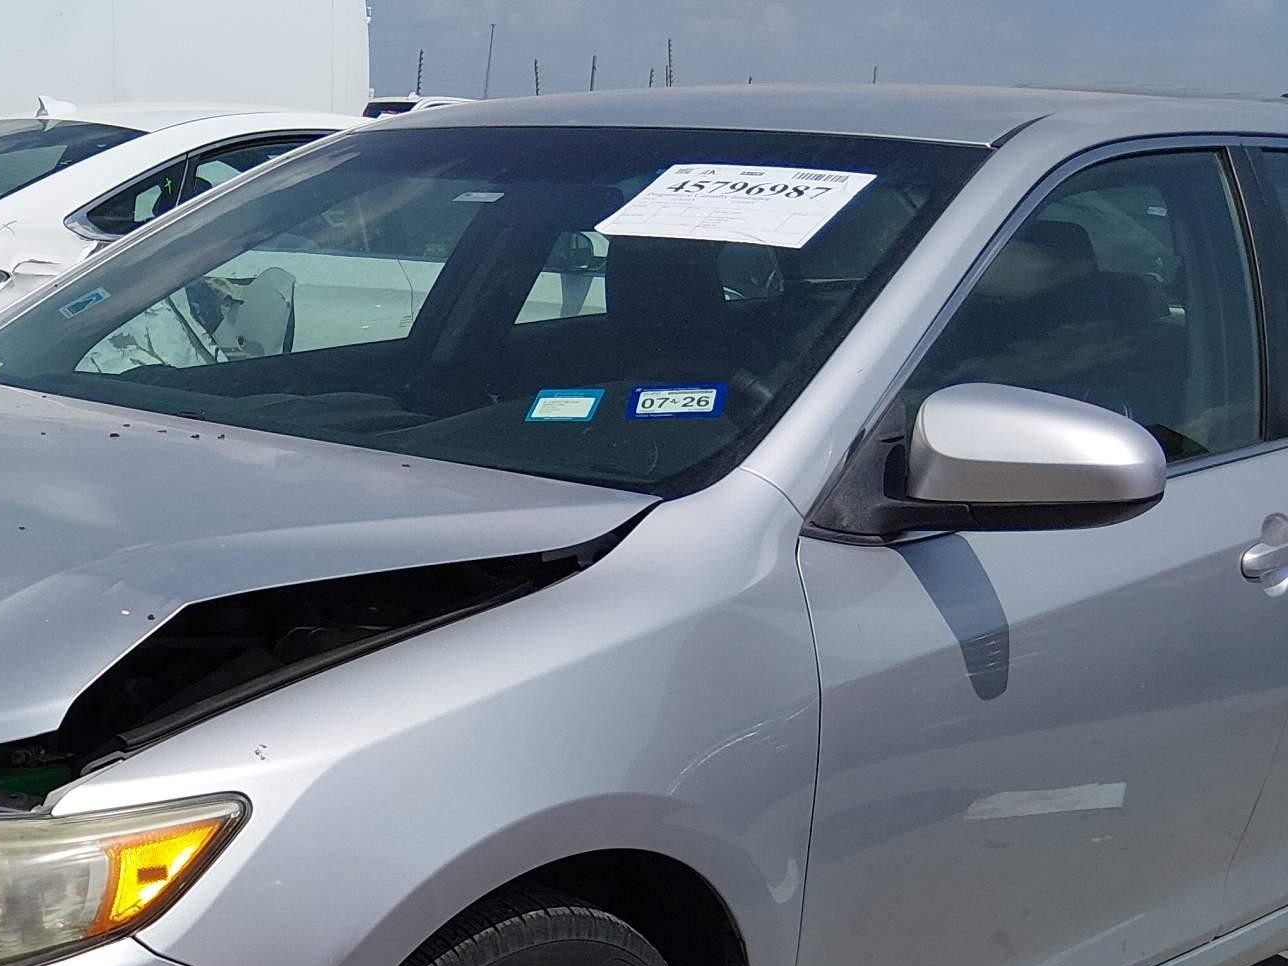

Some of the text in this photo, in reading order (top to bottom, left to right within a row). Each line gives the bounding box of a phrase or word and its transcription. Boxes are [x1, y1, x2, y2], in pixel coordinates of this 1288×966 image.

[667, 180, 833, 199] 45796987
[641, 396, 711, 409] 07 26
